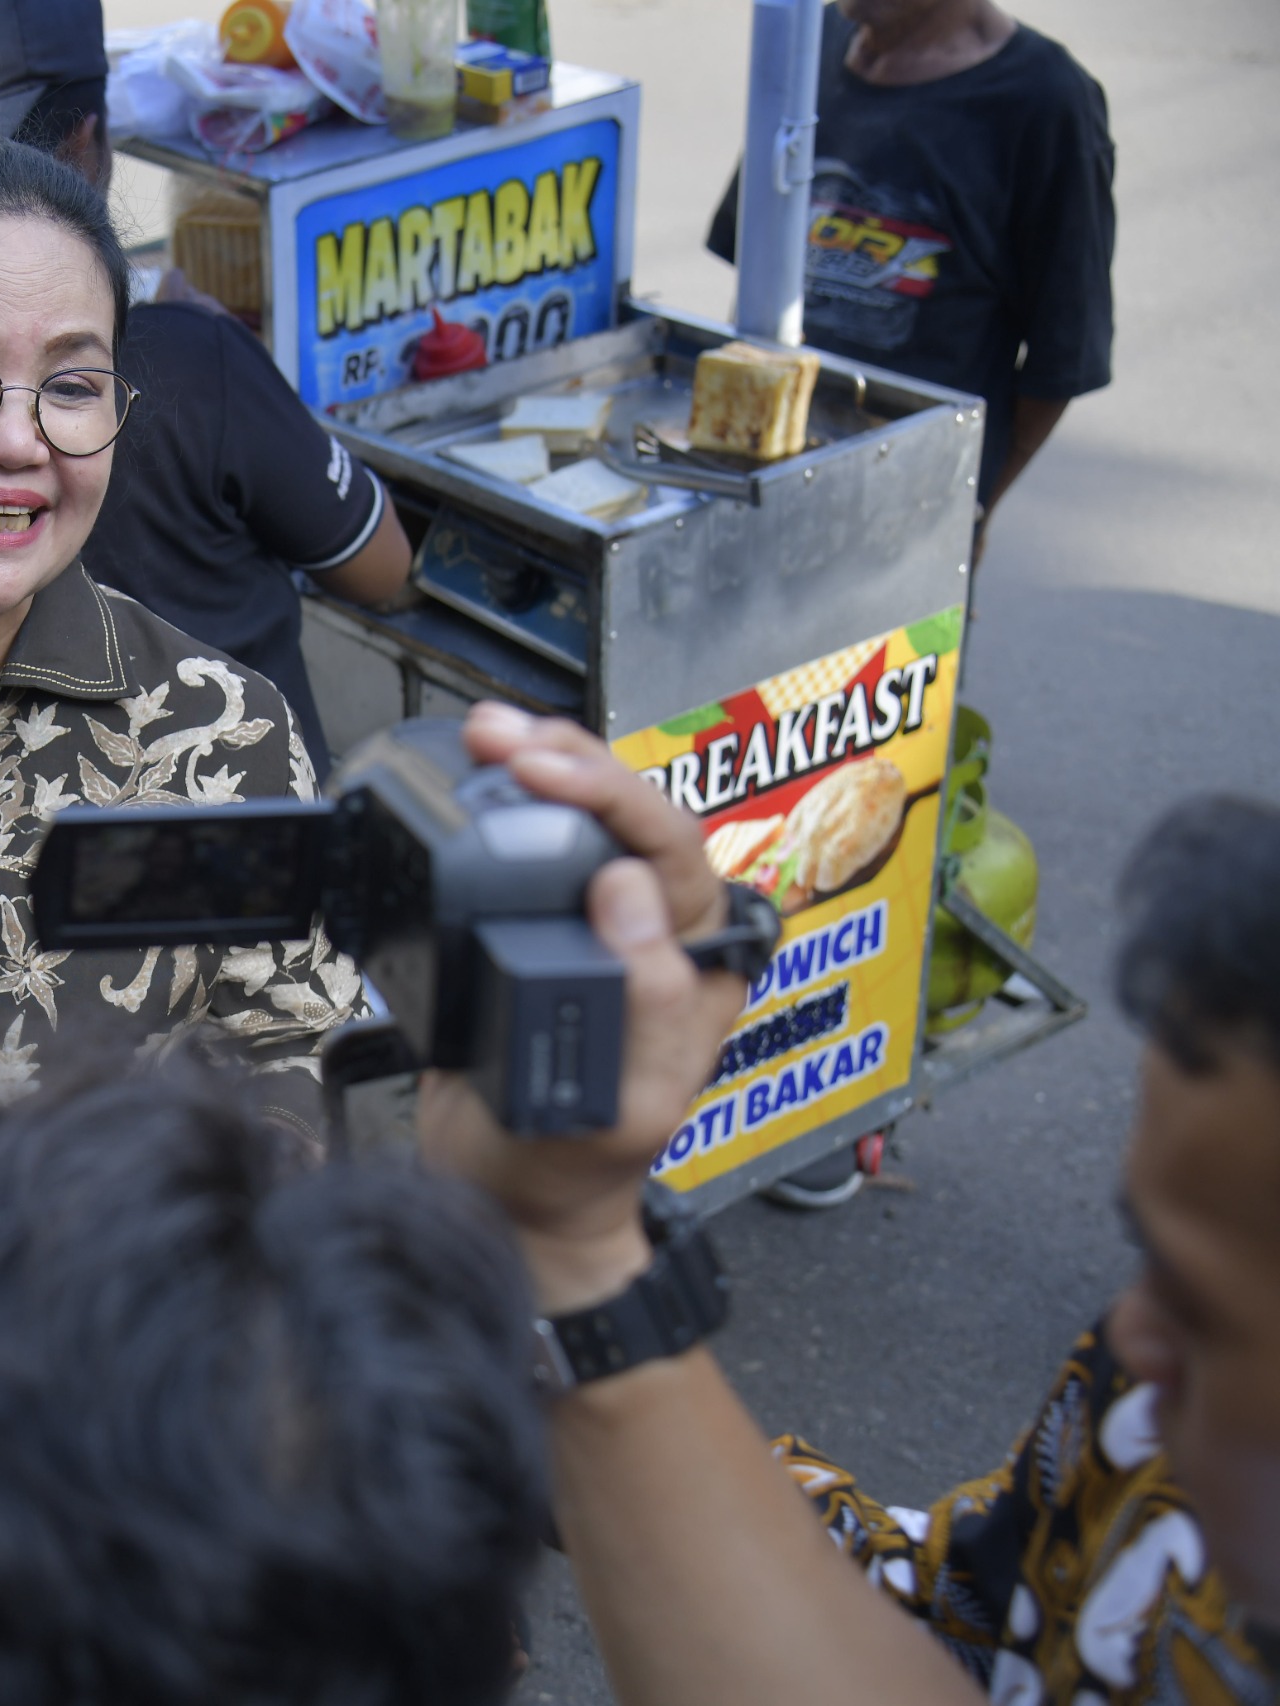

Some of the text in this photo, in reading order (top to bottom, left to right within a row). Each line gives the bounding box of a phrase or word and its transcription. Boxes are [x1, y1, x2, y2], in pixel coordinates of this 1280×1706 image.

[316, 158, 602, 338] MARTABAK
[749, 907, 883, 1007] DWICH
[746, 1029, 884, 1128] BAKAR
